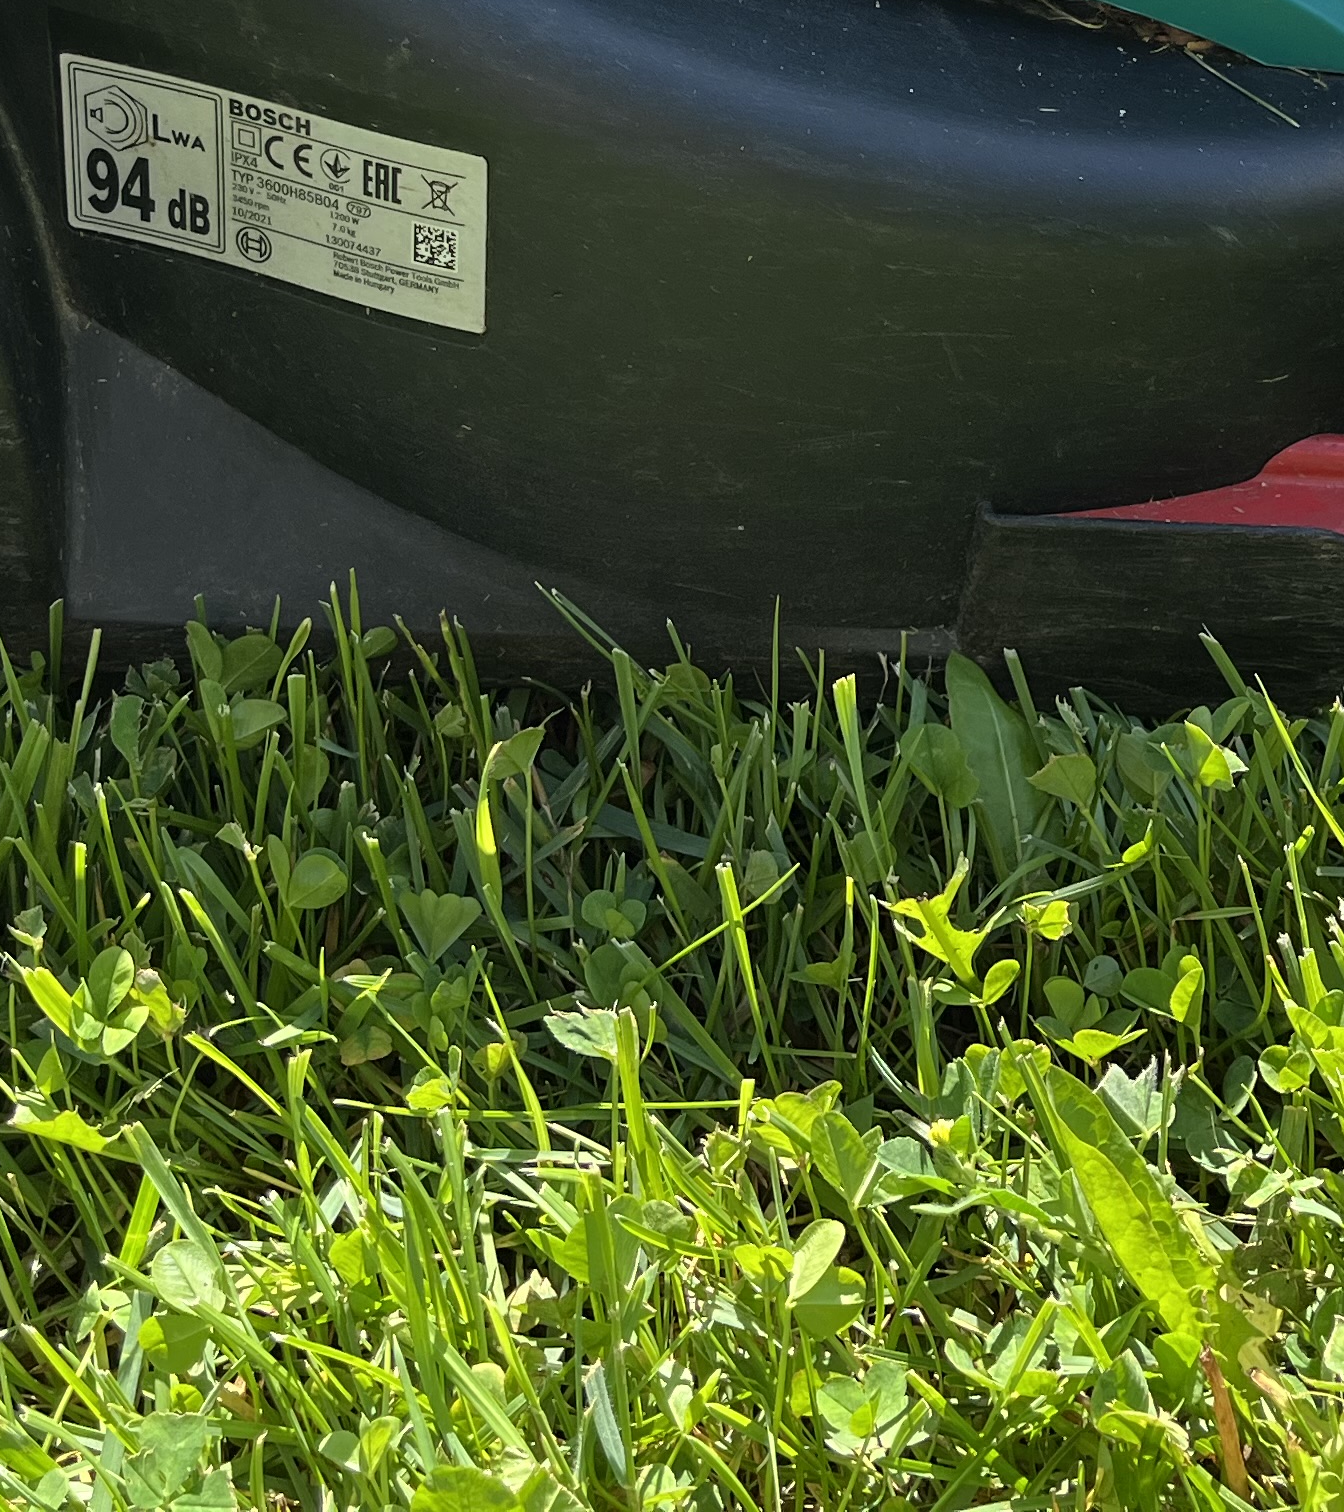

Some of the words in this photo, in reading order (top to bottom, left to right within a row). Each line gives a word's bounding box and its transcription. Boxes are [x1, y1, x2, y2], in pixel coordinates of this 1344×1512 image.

[229, 98, 311, 136] BOSCH
[231, 151, 258, 168] IPX4
[86, 147, 155, 222] 94
[168, 188, 210, 235] dB
[231, 169, 254, 184] TYP
[257, 176, 340, 211] 3600H85B04
[231, 206, 273, 226] 10/2021
[254, 200, 270, 211] rpm
[325, 233, 382, 256] 130074437
[333, 251, 359, 265] Robert
[360, 259, 384, 272] Bosch
[385, 266, 409, 278] Power
[411, 272, 433, 284] Tools
[434, 277, 460, 290] GmbH
[333, 269, 353, 282] Made
[354, 275, 362, 284] in
[363, 278, 395, 295] Hungary
[399, 278, 439, 294] GERMANY
